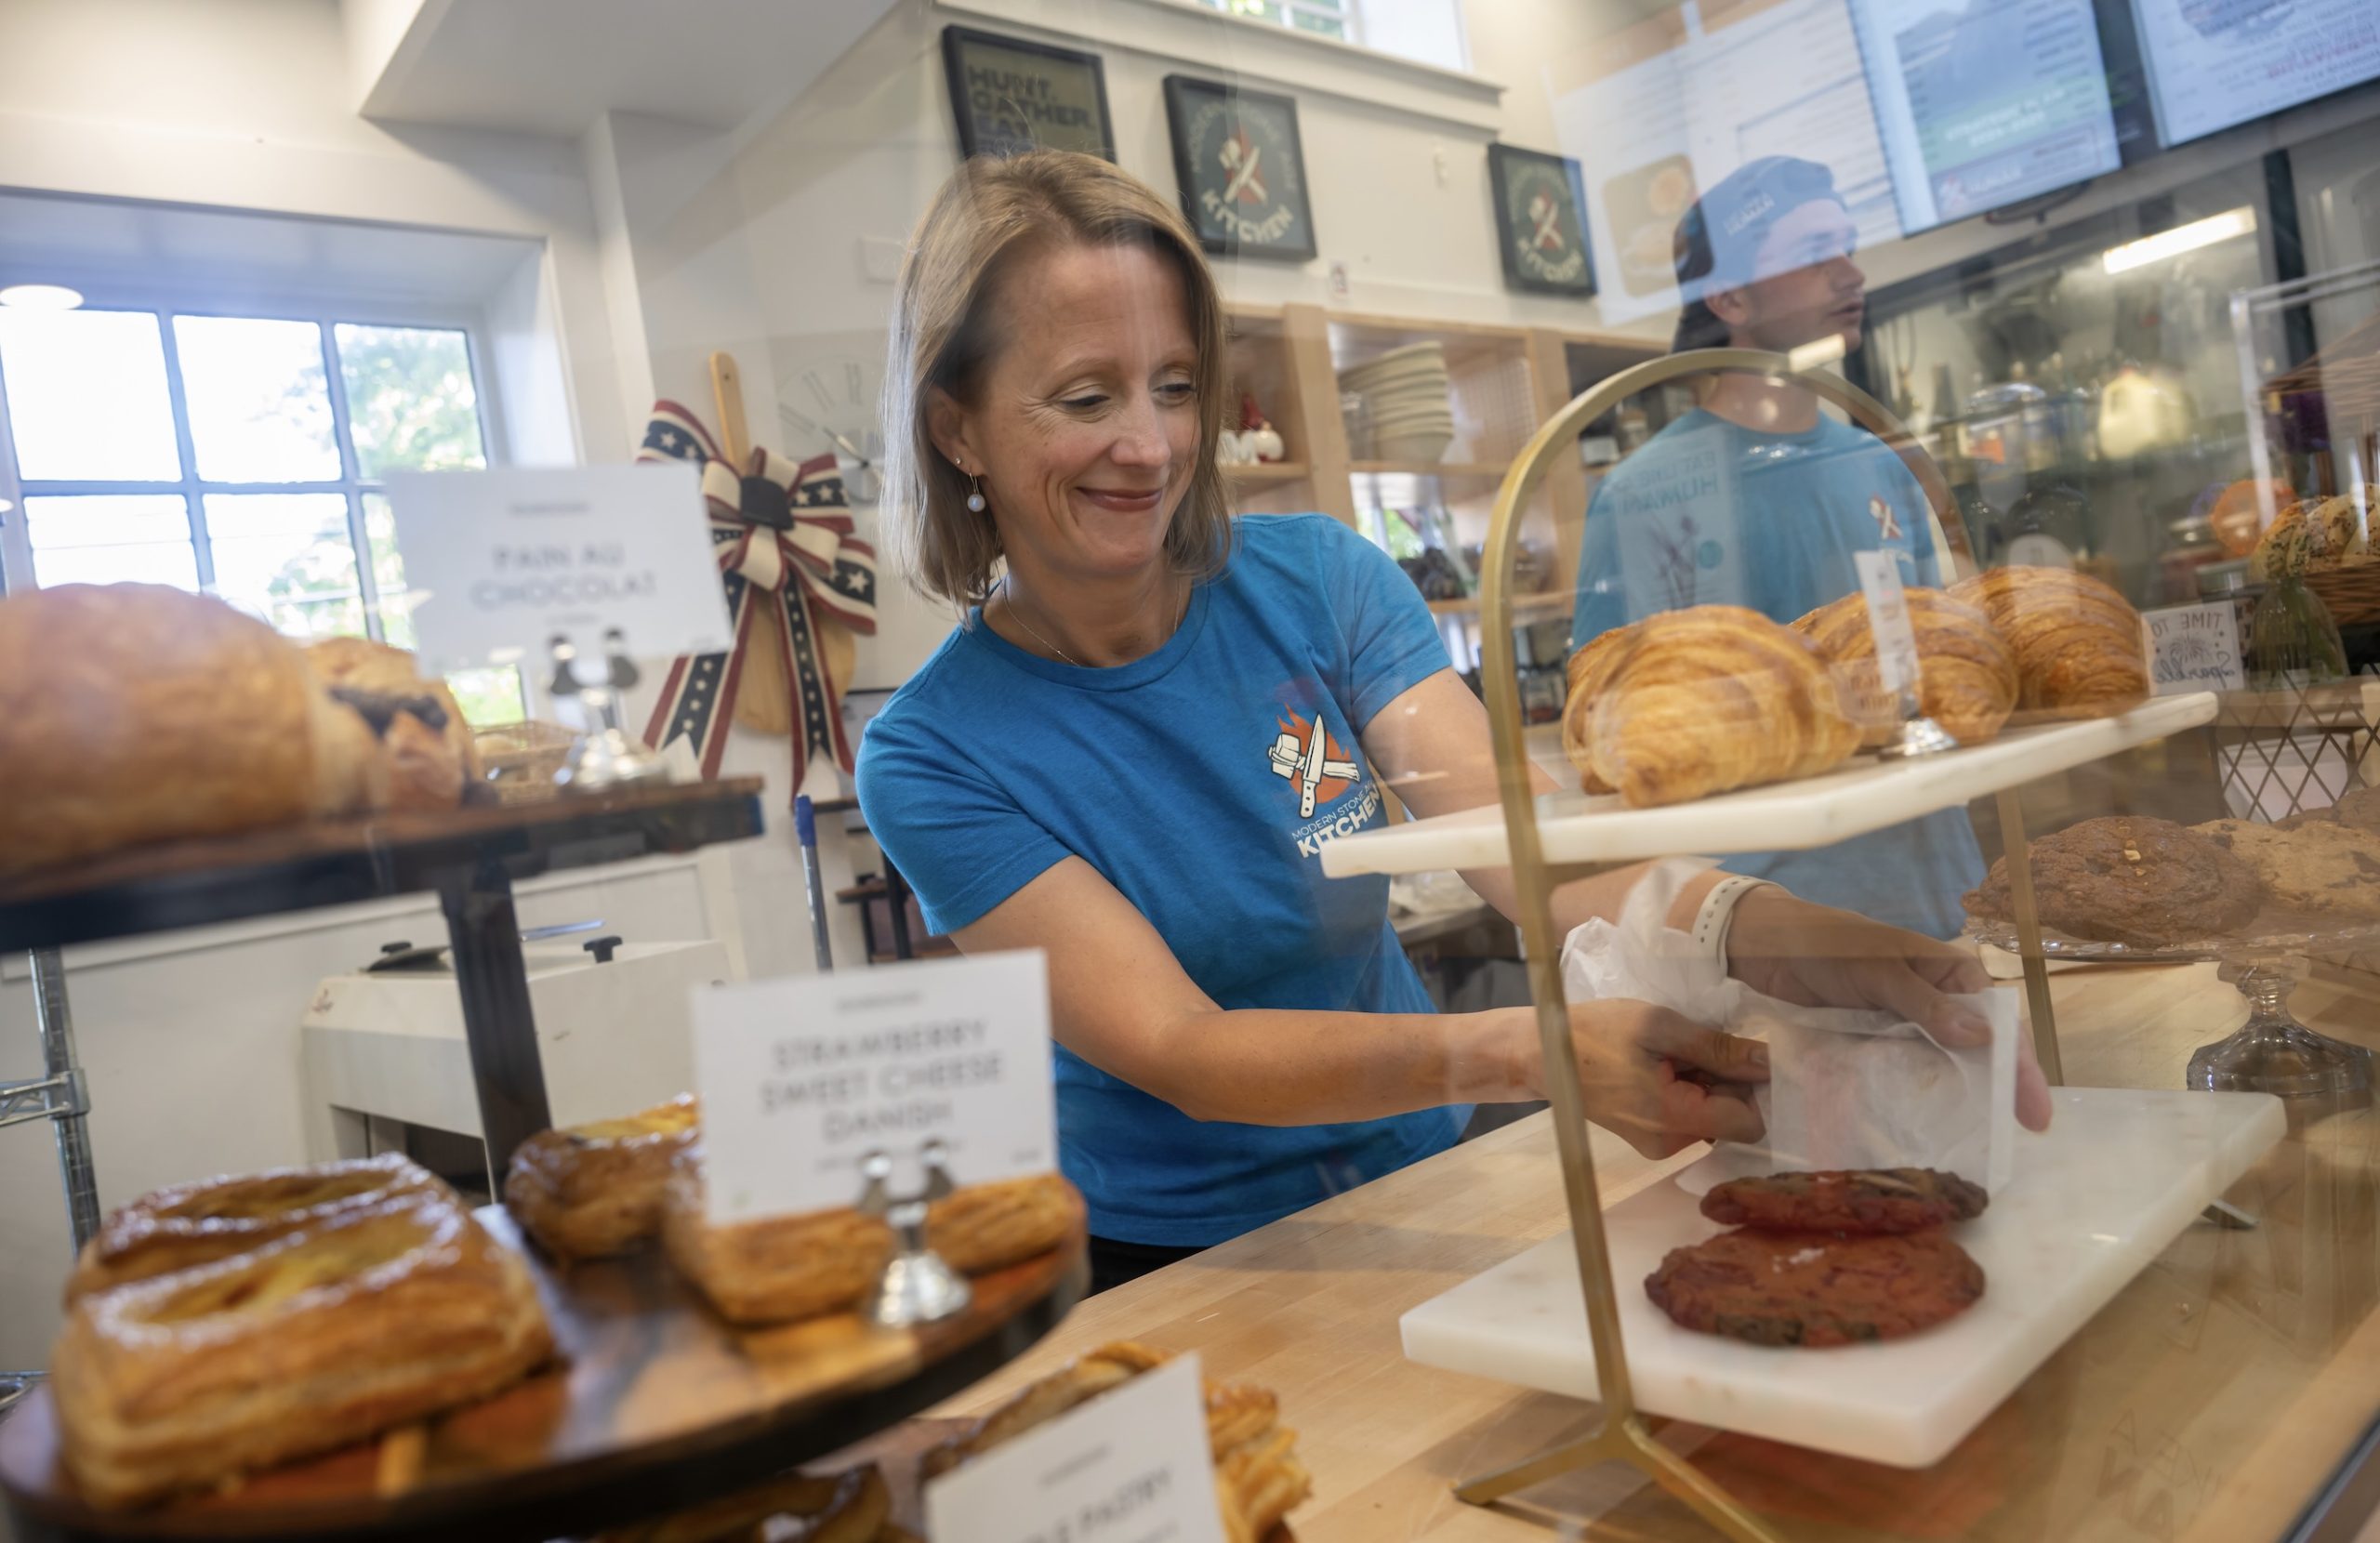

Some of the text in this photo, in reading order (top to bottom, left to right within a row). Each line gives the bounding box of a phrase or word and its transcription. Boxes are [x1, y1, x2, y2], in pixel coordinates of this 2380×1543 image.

[1201, 189, 1294, 244] KITCHEN
[471, 569, 657, 611] CHOCOLAT
[1291, 811, 1338, 840] MODERN
[1337, 790, 1366, 816] STONE
[1297, 783, 1381, 859] KITCHEN
[773, 1018, 990, 1072] STRAWBERRY
[758, 1048, 1004, 1115] SWEET CHEESE
